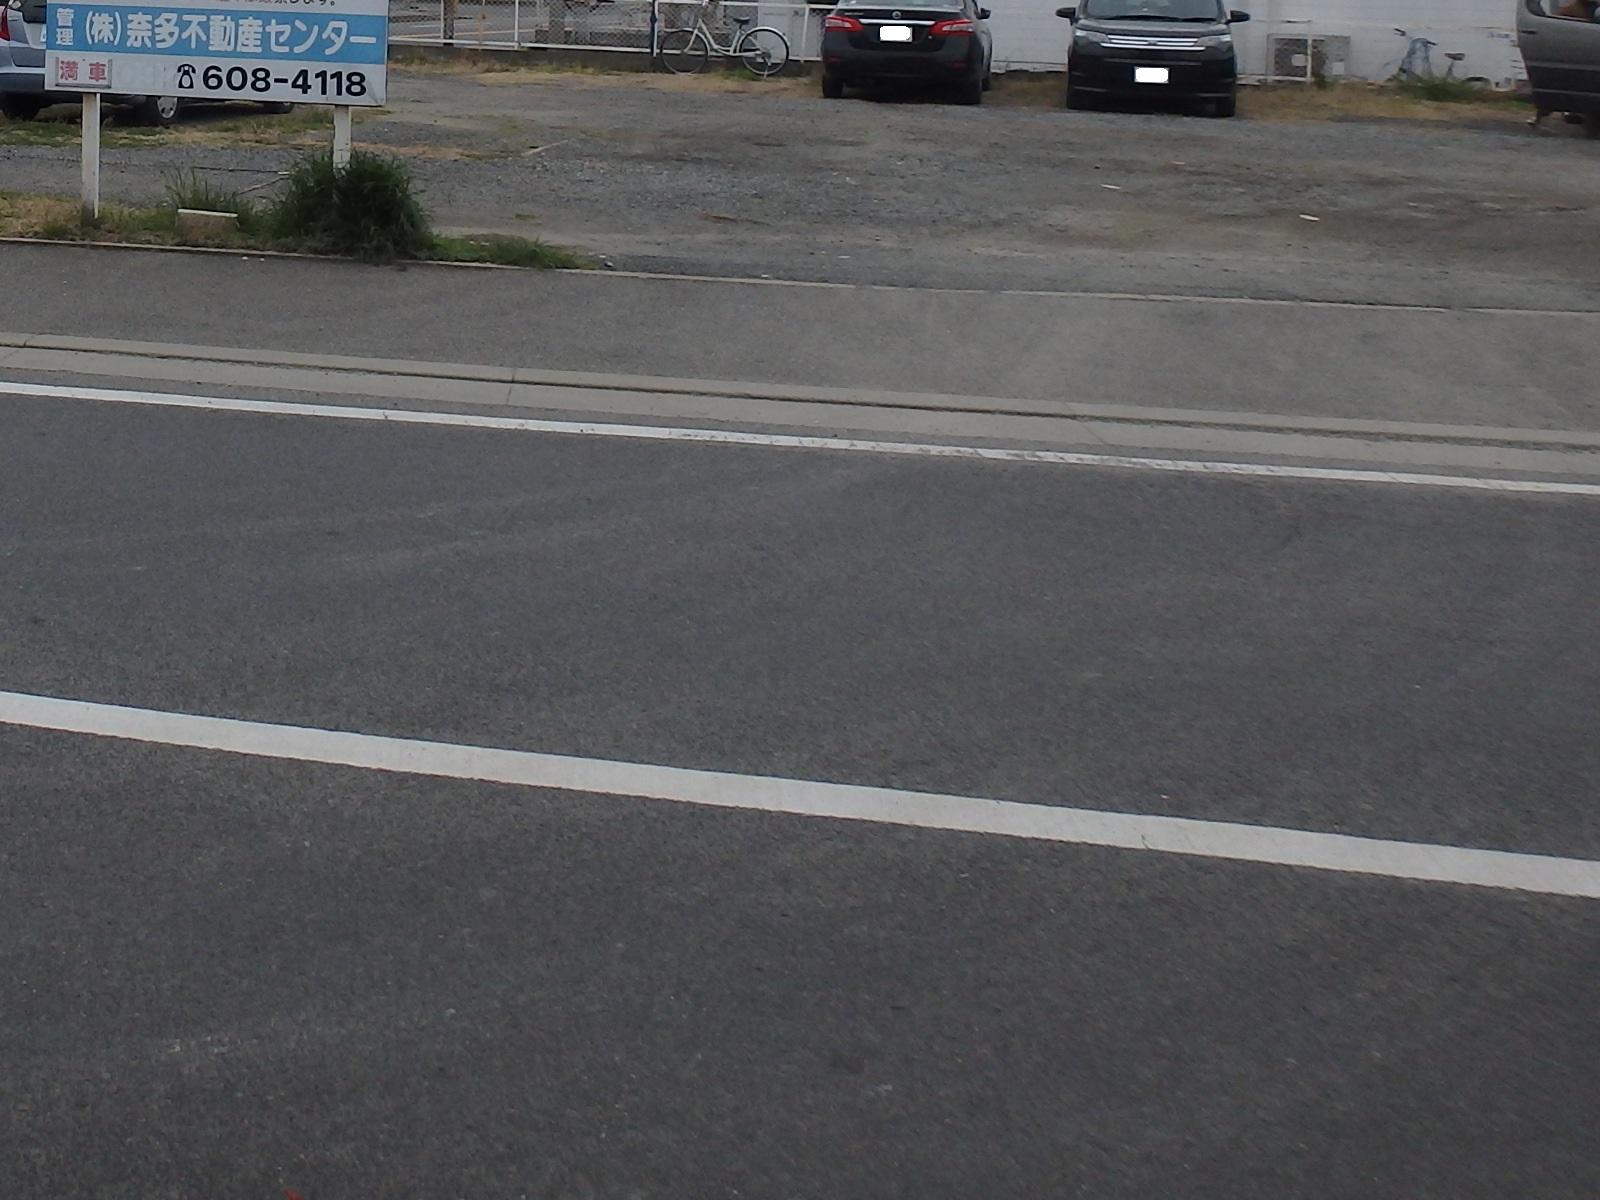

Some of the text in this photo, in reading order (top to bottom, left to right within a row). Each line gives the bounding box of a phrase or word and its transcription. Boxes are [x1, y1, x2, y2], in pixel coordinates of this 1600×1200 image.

[55, 7, 75, 47] 管理
[59, 60, 108, 83] 満車
[201, 64, 368, 98] 608-4118
